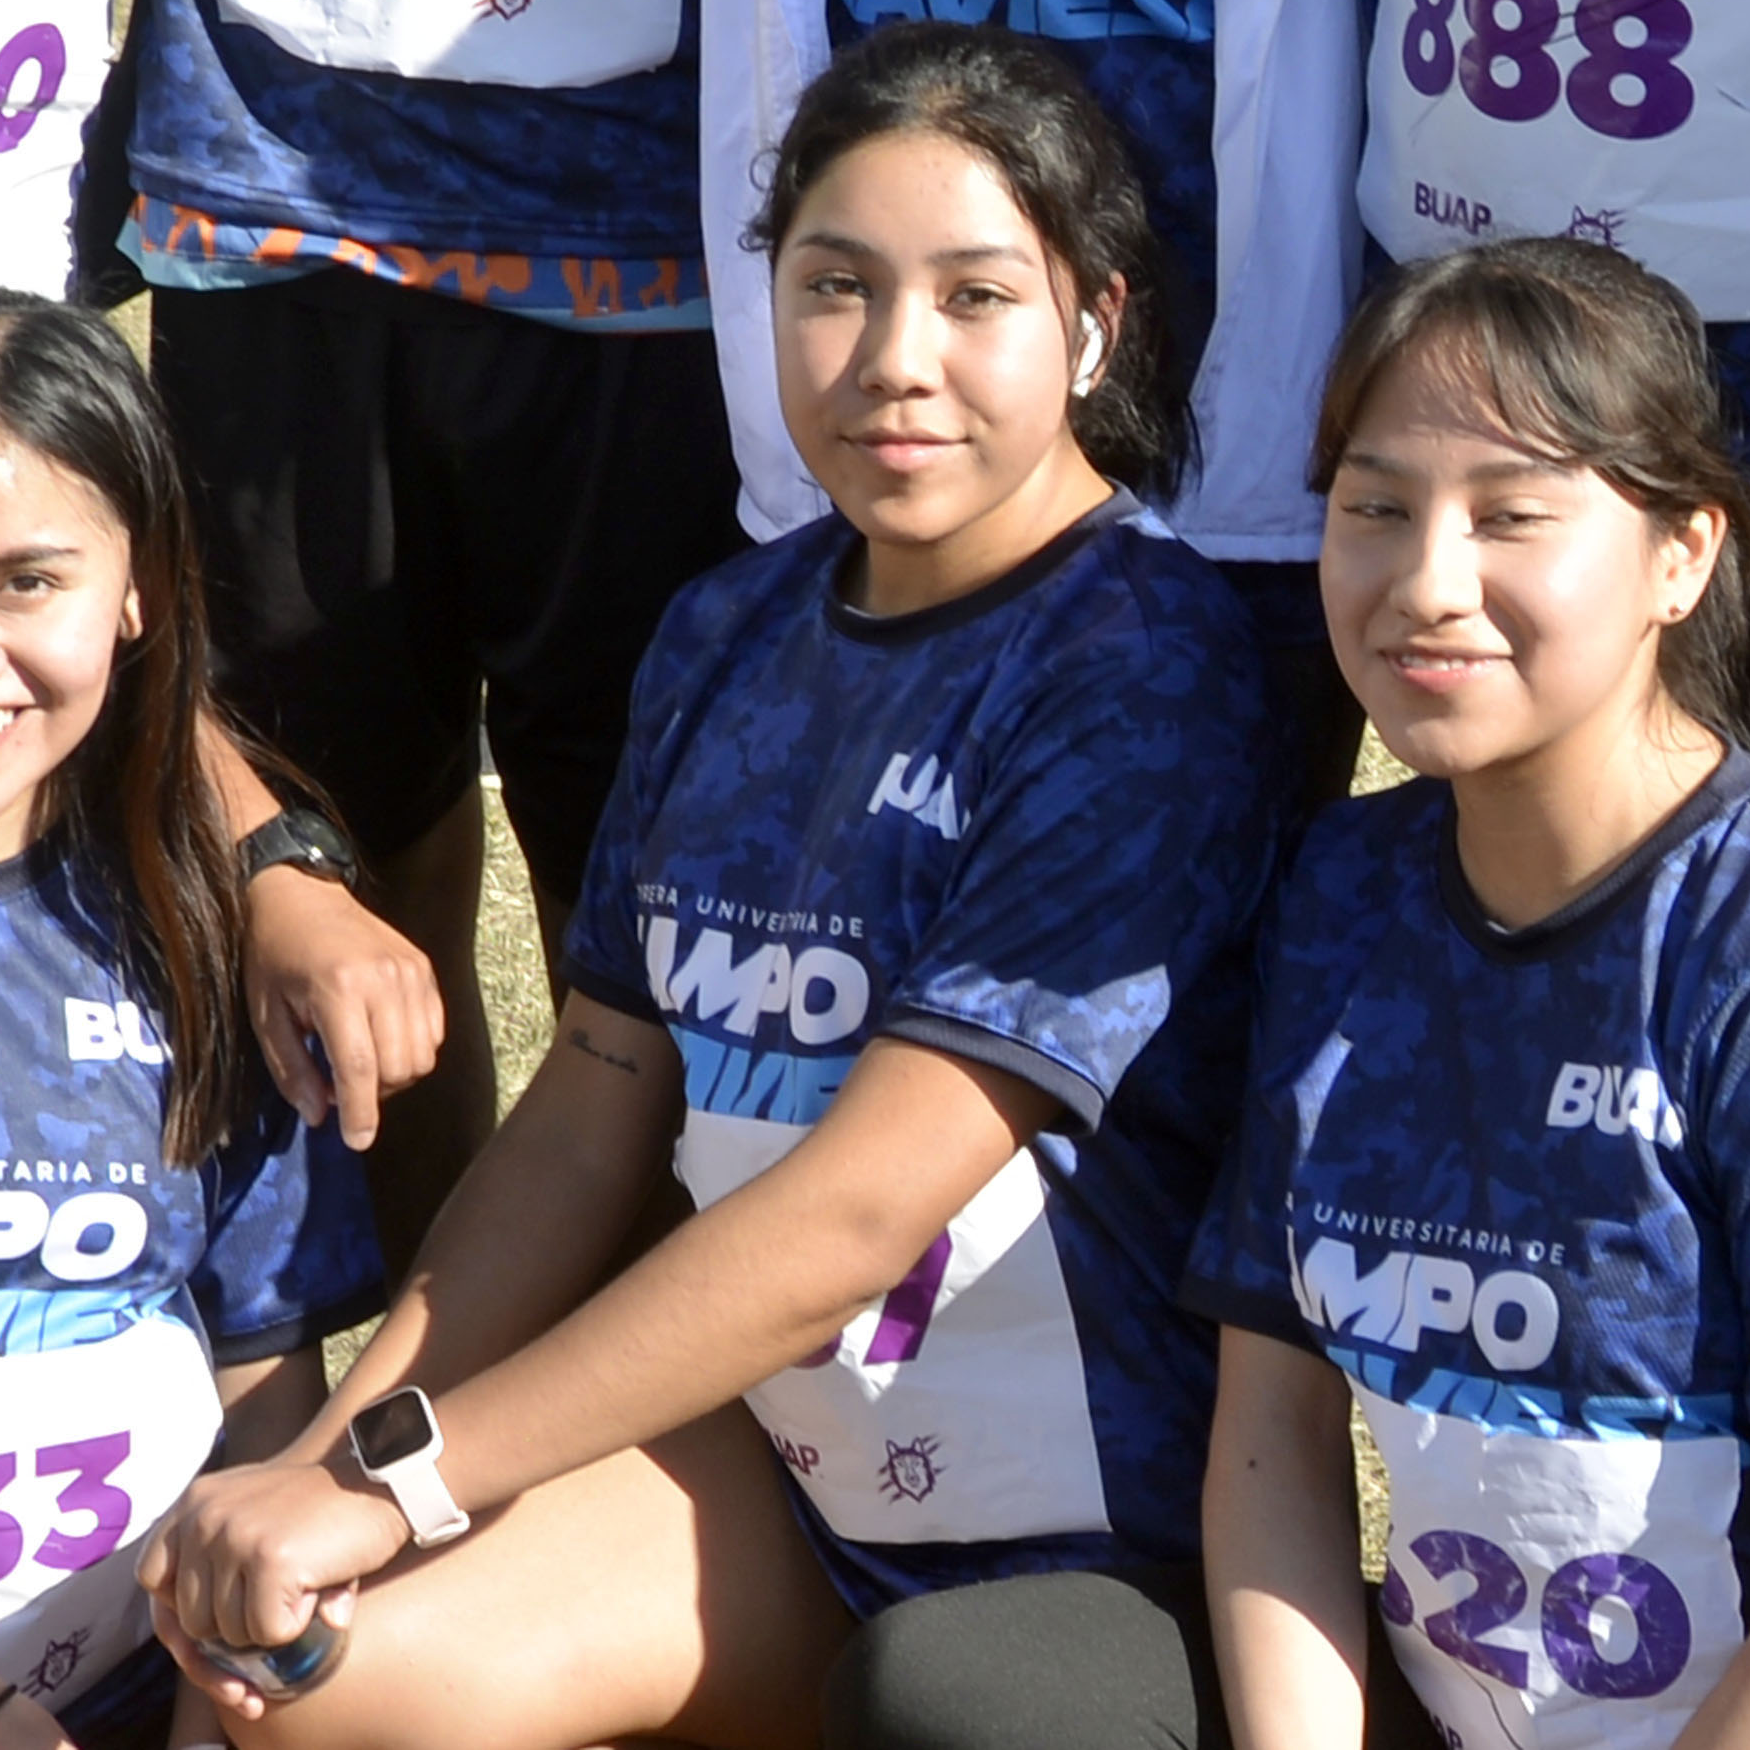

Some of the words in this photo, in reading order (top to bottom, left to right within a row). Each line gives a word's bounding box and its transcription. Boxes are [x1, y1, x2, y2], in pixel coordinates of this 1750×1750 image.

[1413, 181, 1492, 236] BUAP
[828, 914, 864, 938] DE
[109, 1158, 147, 1184] DE
[1314, 1202, 1512, 1256] UNIVERSITARIA
[1526, 1237, 1566, 1265] DE
